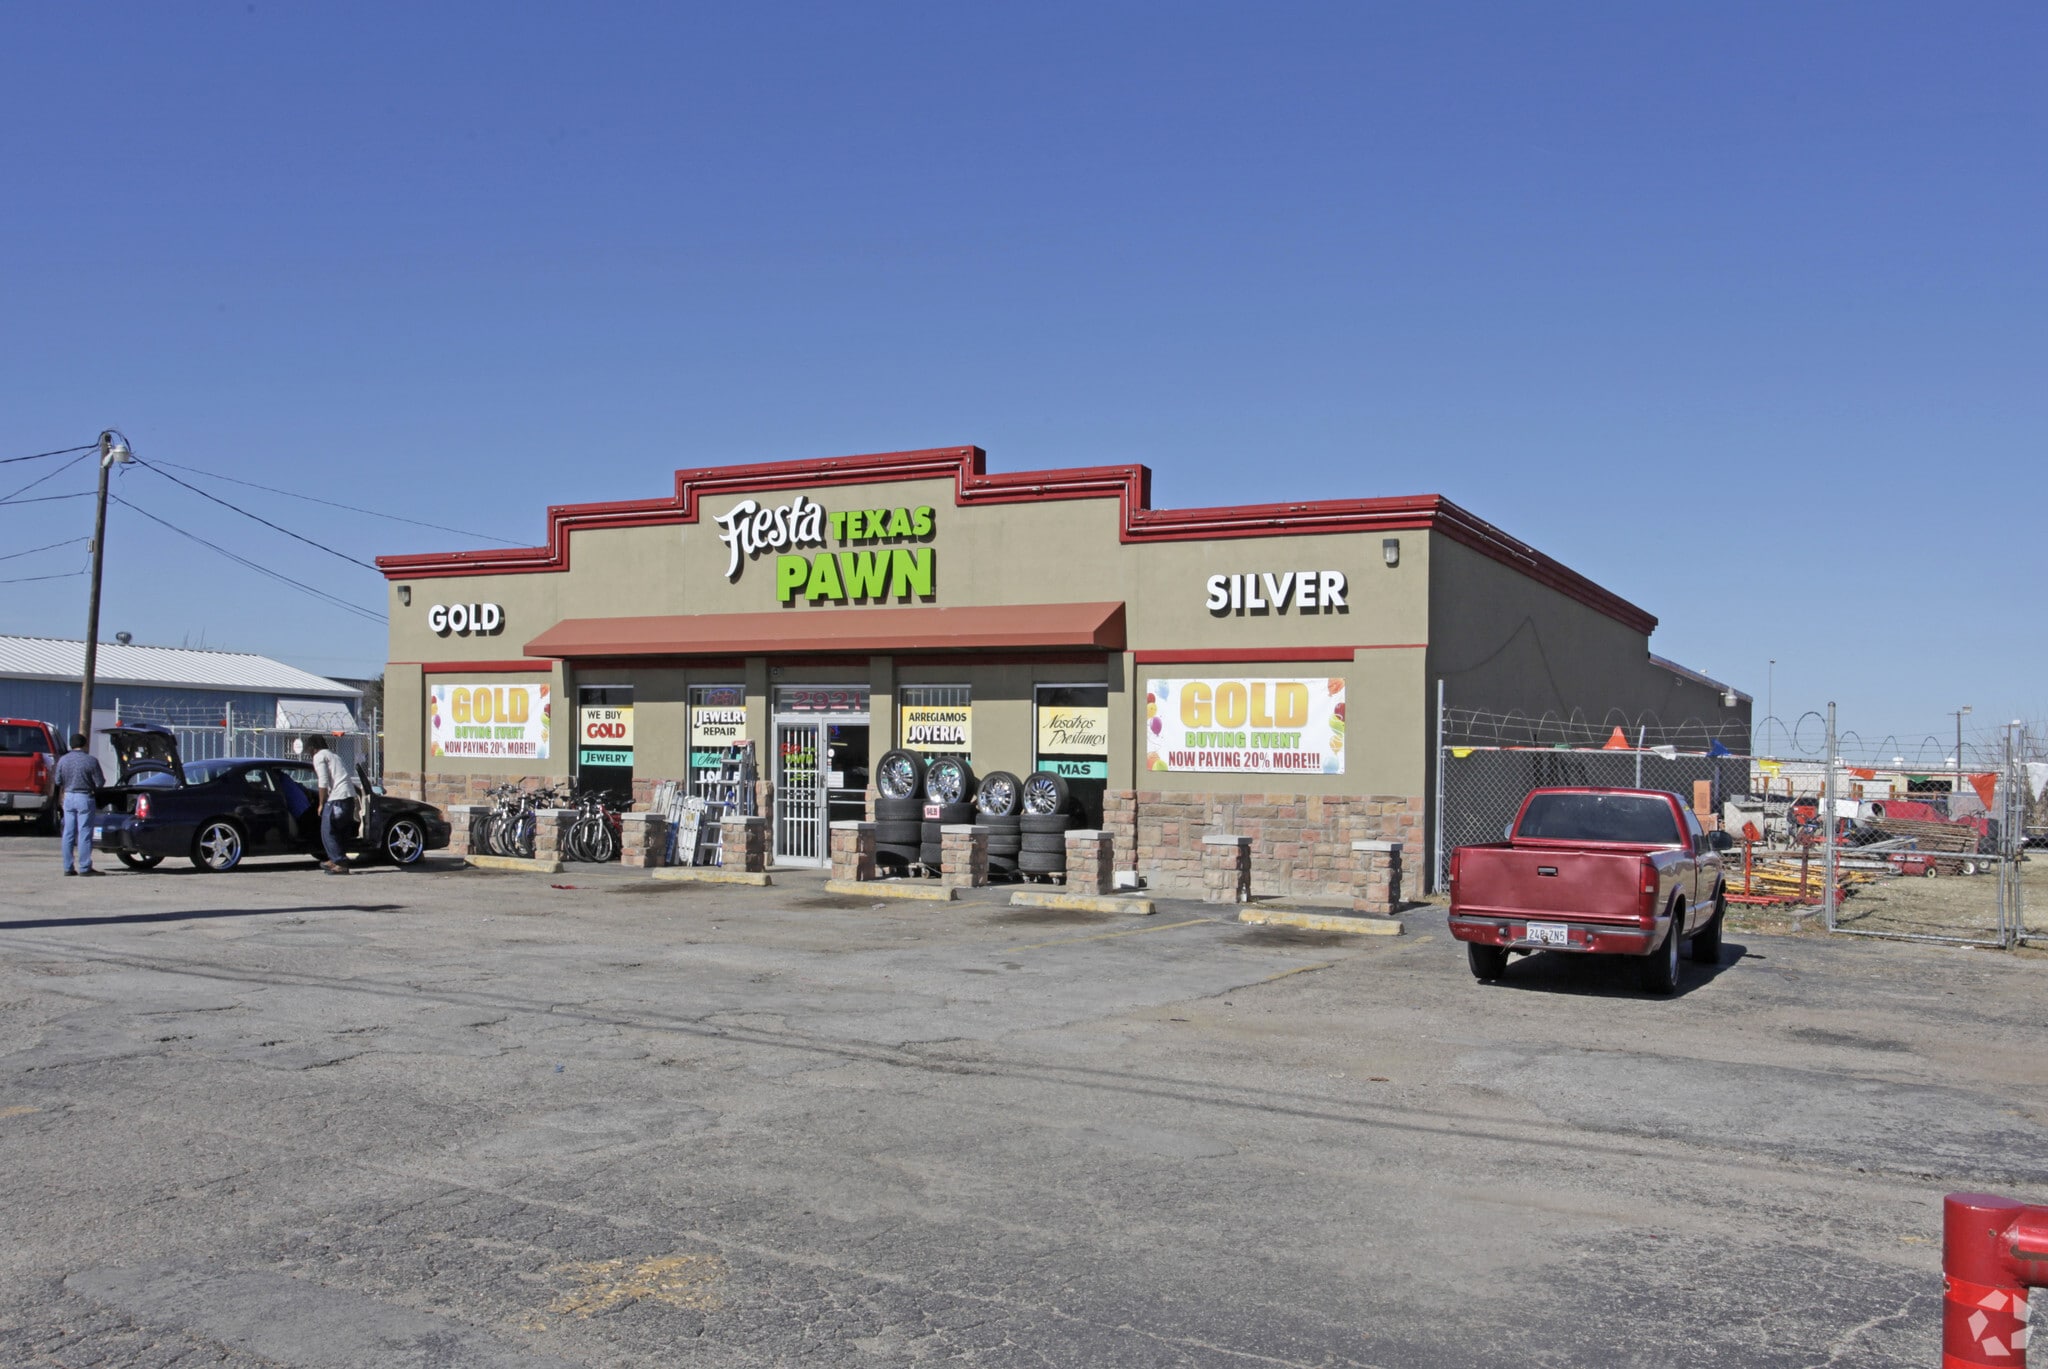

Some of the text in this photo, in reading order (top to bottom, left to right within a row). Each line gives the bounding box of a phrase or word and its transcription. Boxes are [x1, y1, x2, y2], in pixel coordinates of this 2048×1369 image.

[713, 495, 933, 578] Fiesta TEXAS
[776, 547, 932, 602] PAWN
[1205, 570, 1346, 611] SILVER
[428, 603, 501, 632] GOLD
[452, 687, 529, 724] GOLD
[792, 690, 862, 710] 2921
[1180, 681, 1309, 729] GOLD
[587, 710, 622, 720] WE BUY
[695, 709, 746, 728] JEWELRY
[908, 712, 967, 722] ARREGLAMOS
[1042, 714, 1096, 729] Nosotros
[454, 726, 525, 739] BUYING EVENT
[587, 723, 626, 739] GOLD
[703, 727, 736, 736] REPAIR
[907, 725, 966, 744] JOYERIA
[1049, 729, 1106, 747] Prestamos
[1185, 731, 1301, 749] BUYING EVENT
[444, 741, 536, 755] NOW PAYING 20% MORE!!!
[585, 752, 628, 763] JEWELRY
[1168, 751, 1320, 769] NOW PAYING 20% MORE!!!
[1057, 763, 1091, 775] MAS
